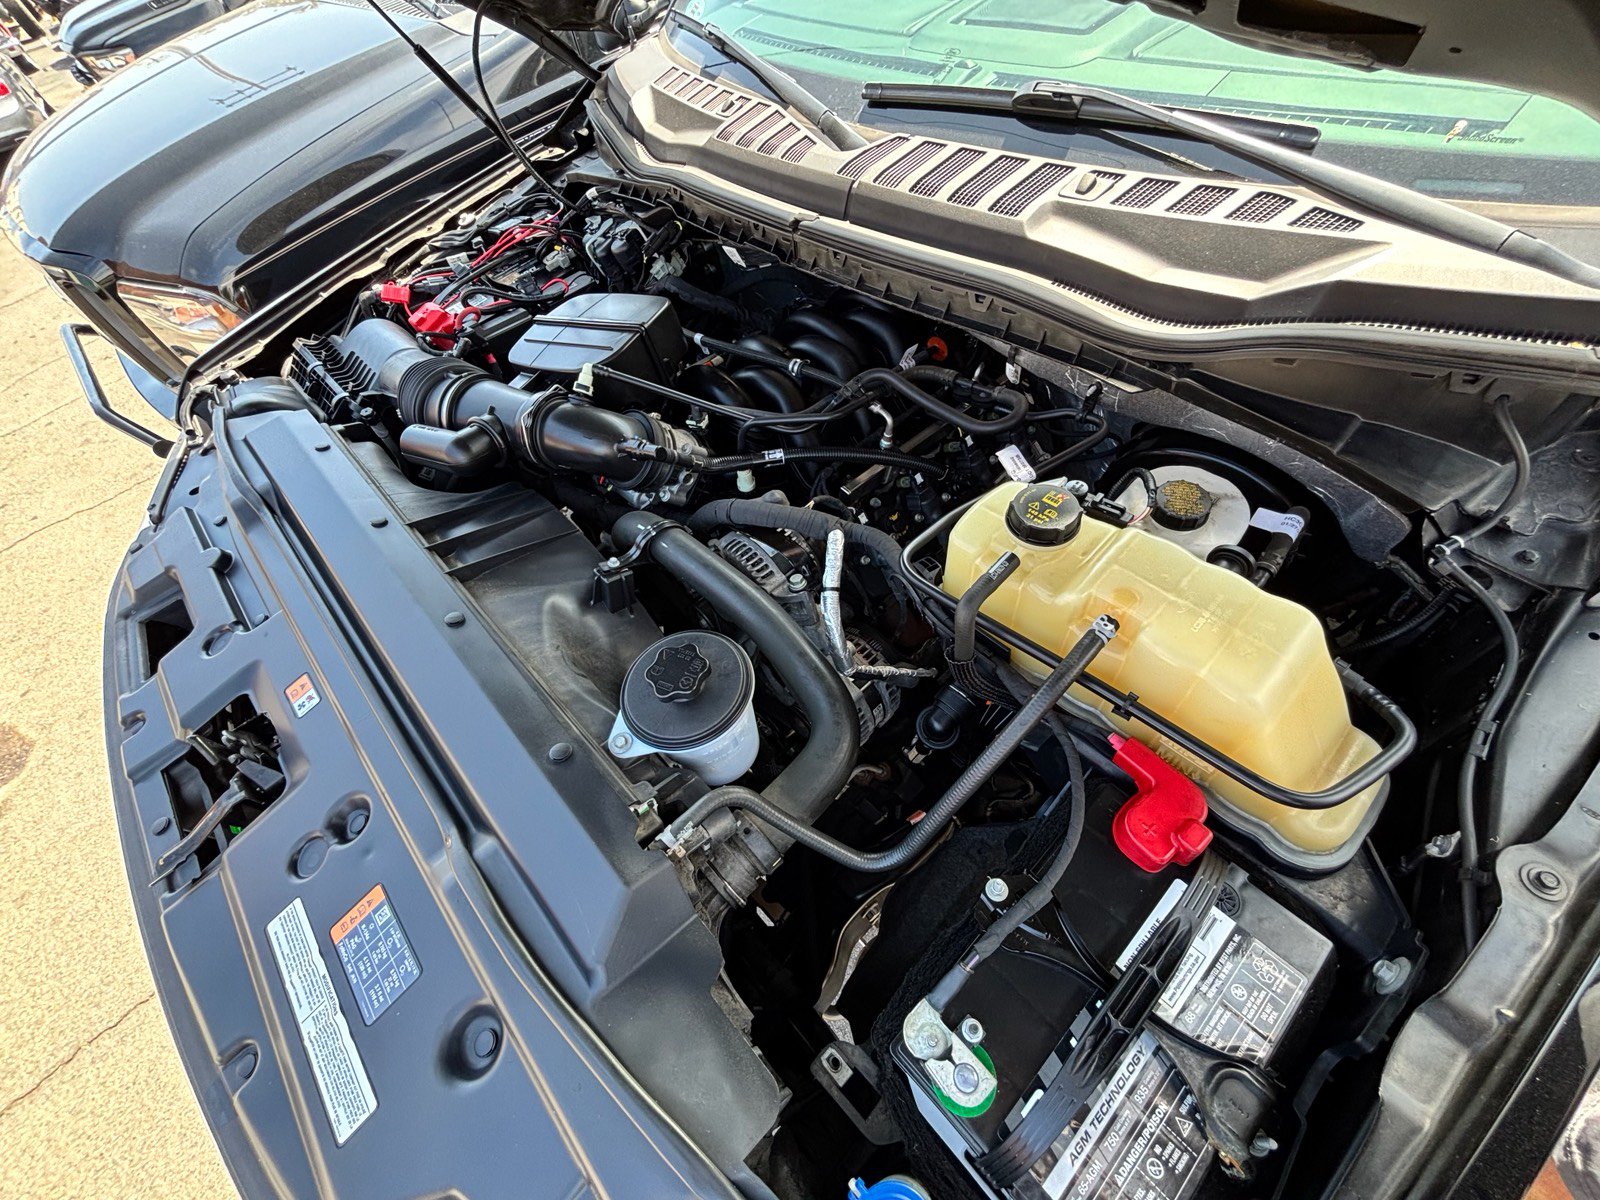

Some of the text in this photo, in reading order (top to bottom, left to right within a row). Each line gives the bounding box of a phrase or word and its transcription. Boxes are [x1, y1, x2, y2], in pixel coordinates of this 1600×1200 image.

[320, 973, 338, 1016] MODIFICATIONS
[1184, 1010, 1196, 1023] 68
[1259, 1011, 1268, 1021] DO
[1070, 1043, 1146, 1167] AGM TECHNOLOGY
[1133, 1084, 1149, 1105] 935
[1104, 1130, 1120, 1152] 750
[1118, 1101, 1167, 1177] DANGER/POISON
[1152, 1143, 1162, 1155] NO
[1076, 1158, 1103, 1195] 65-AGM
